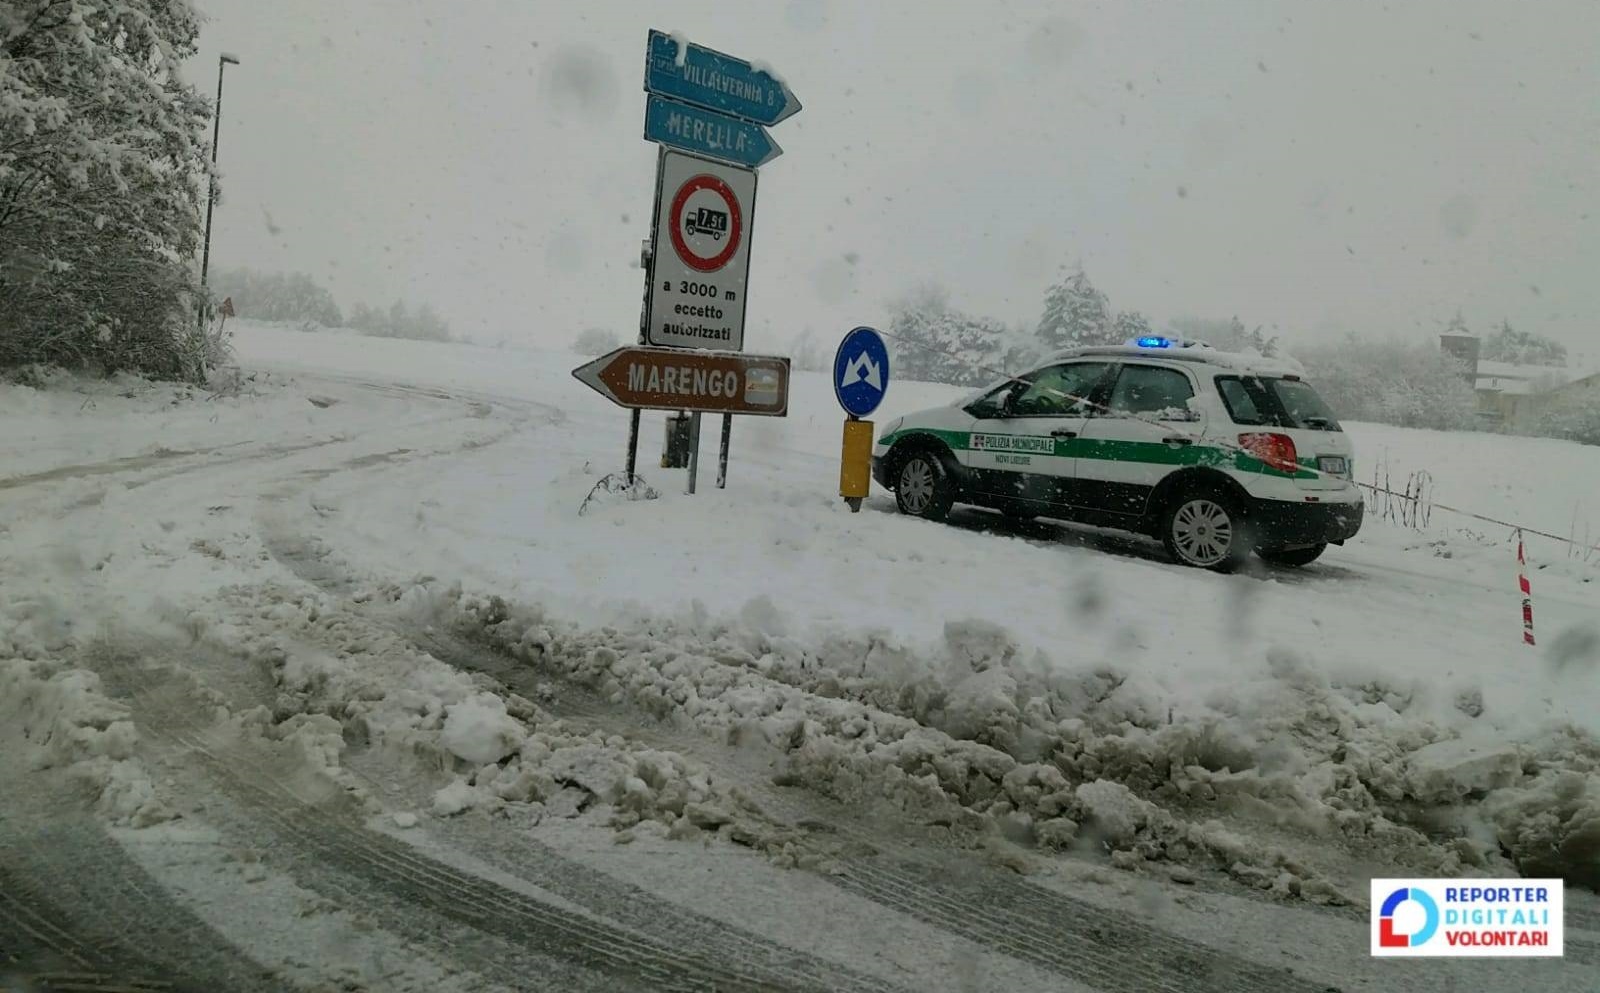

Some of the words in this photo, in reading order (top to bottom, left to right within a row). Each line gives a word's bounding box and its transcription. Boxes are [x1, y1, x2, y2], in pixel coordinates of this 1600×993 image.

[683, 63, 763, 103] VILLALVERNIA
[767, 90, 775, 106] 8
[669, 112, 745, 152] MERELLA
[663, 281, 671, 291] a
[680, 281, 718, 298] 3000
[725, 290, 736, 301] m
[674, 304, 723, 319] eccetto
[663, 322, 731, 340] autorizzati
[628, 363, 738, 398] MARENGO
[985, 436, 1010, 448] POLIZIA
